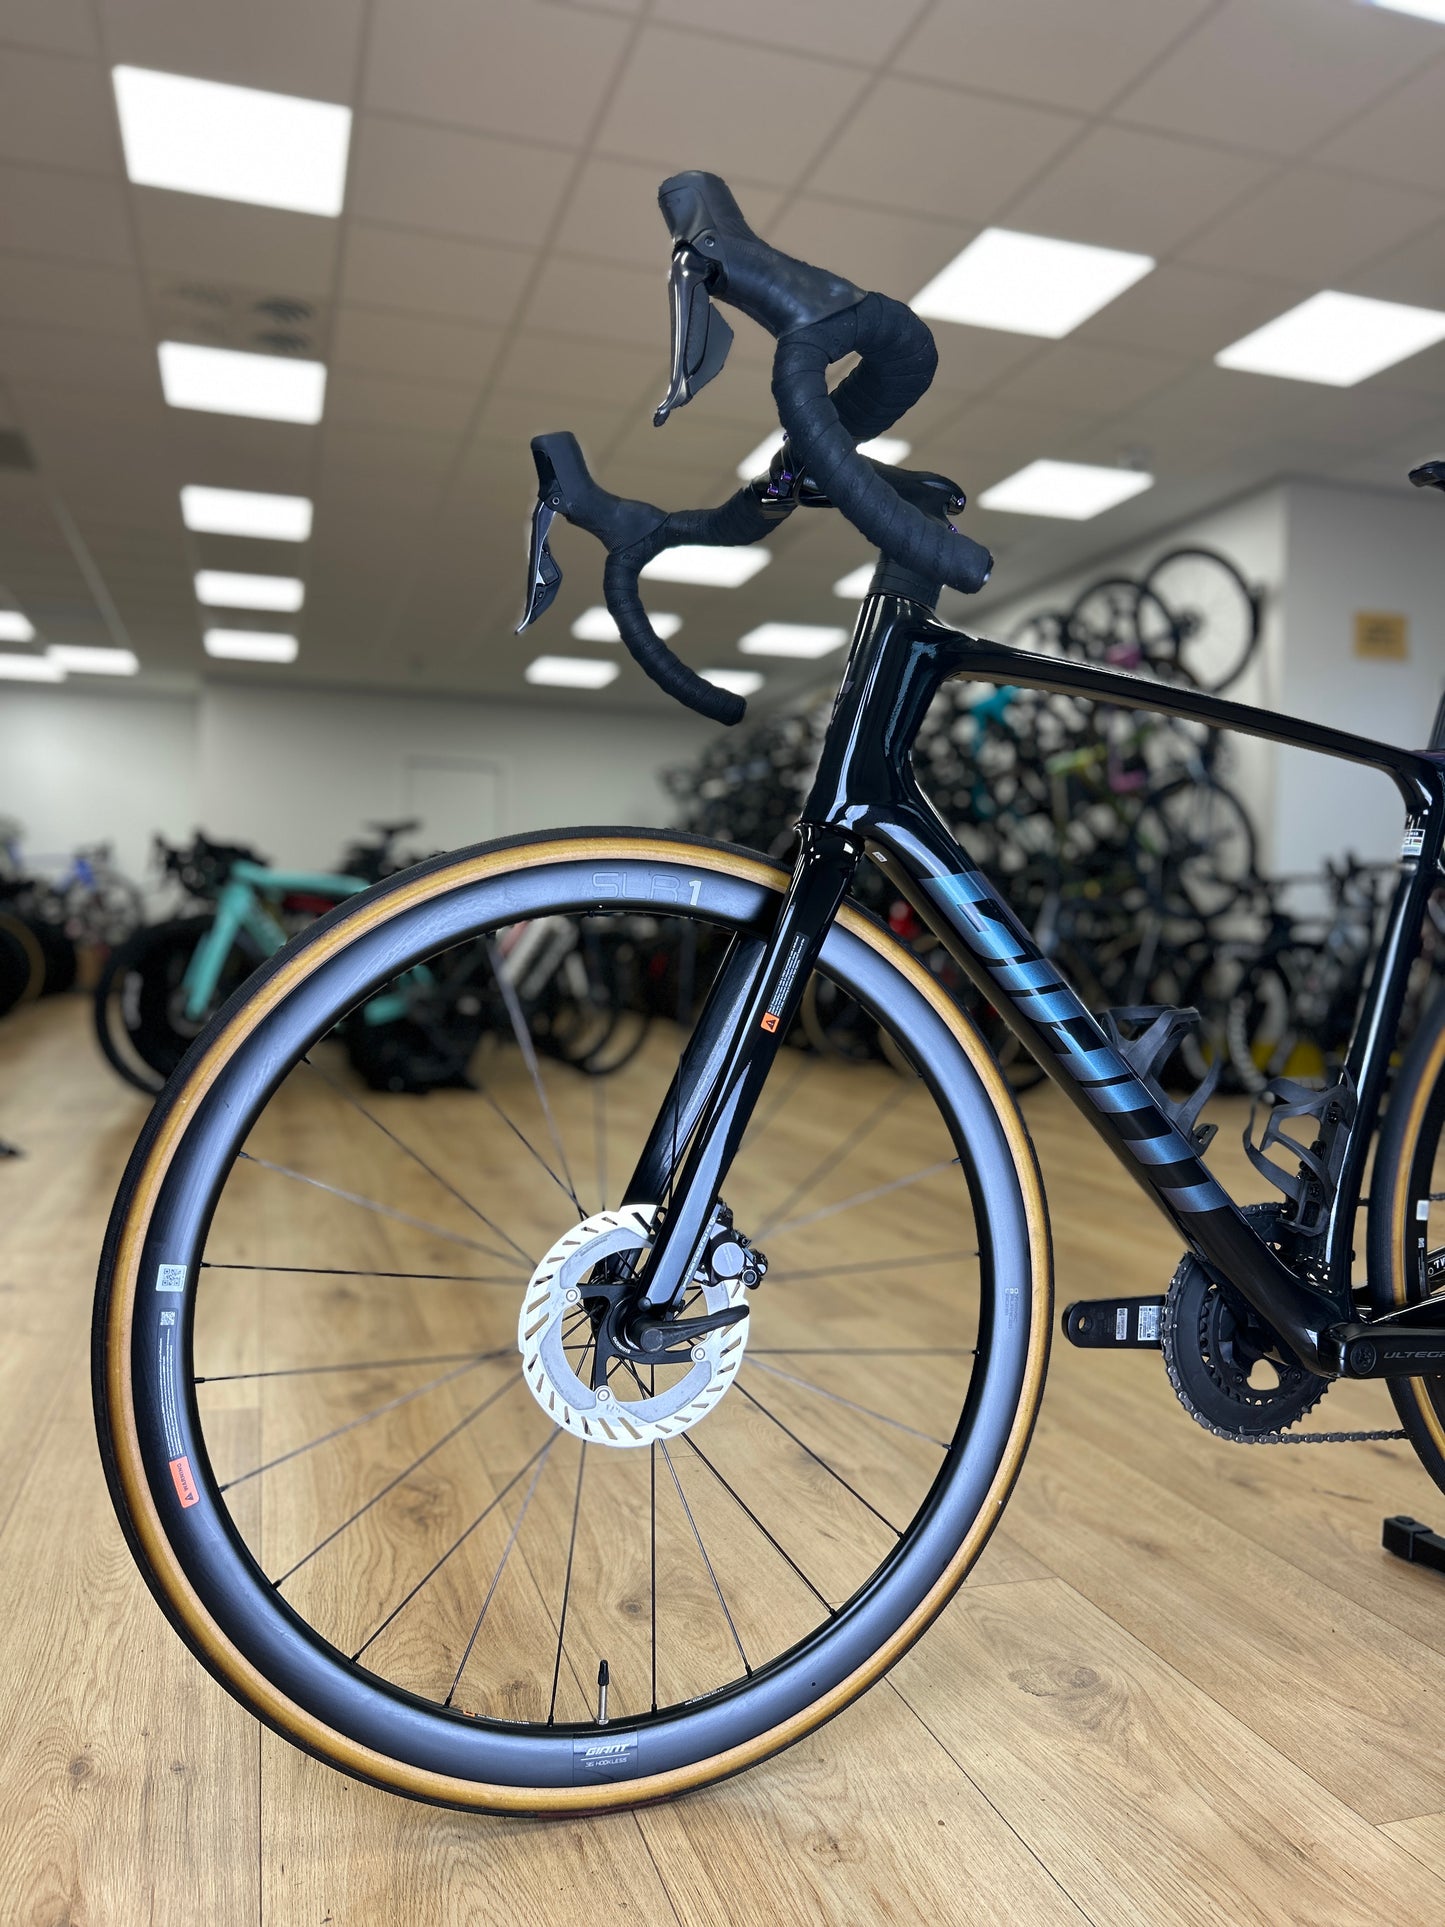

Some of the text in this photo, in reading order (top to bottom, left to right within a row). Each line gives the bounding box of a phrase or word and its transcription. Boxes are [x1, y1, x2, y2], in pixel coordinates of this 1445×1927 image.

[592, 872, 702, 906] SLR 1
[918, 871, 1232, 1213] GIANT
[176, 1462, 189, 1492] WARNING
[585, 1743, 630, 1756] GIANT
